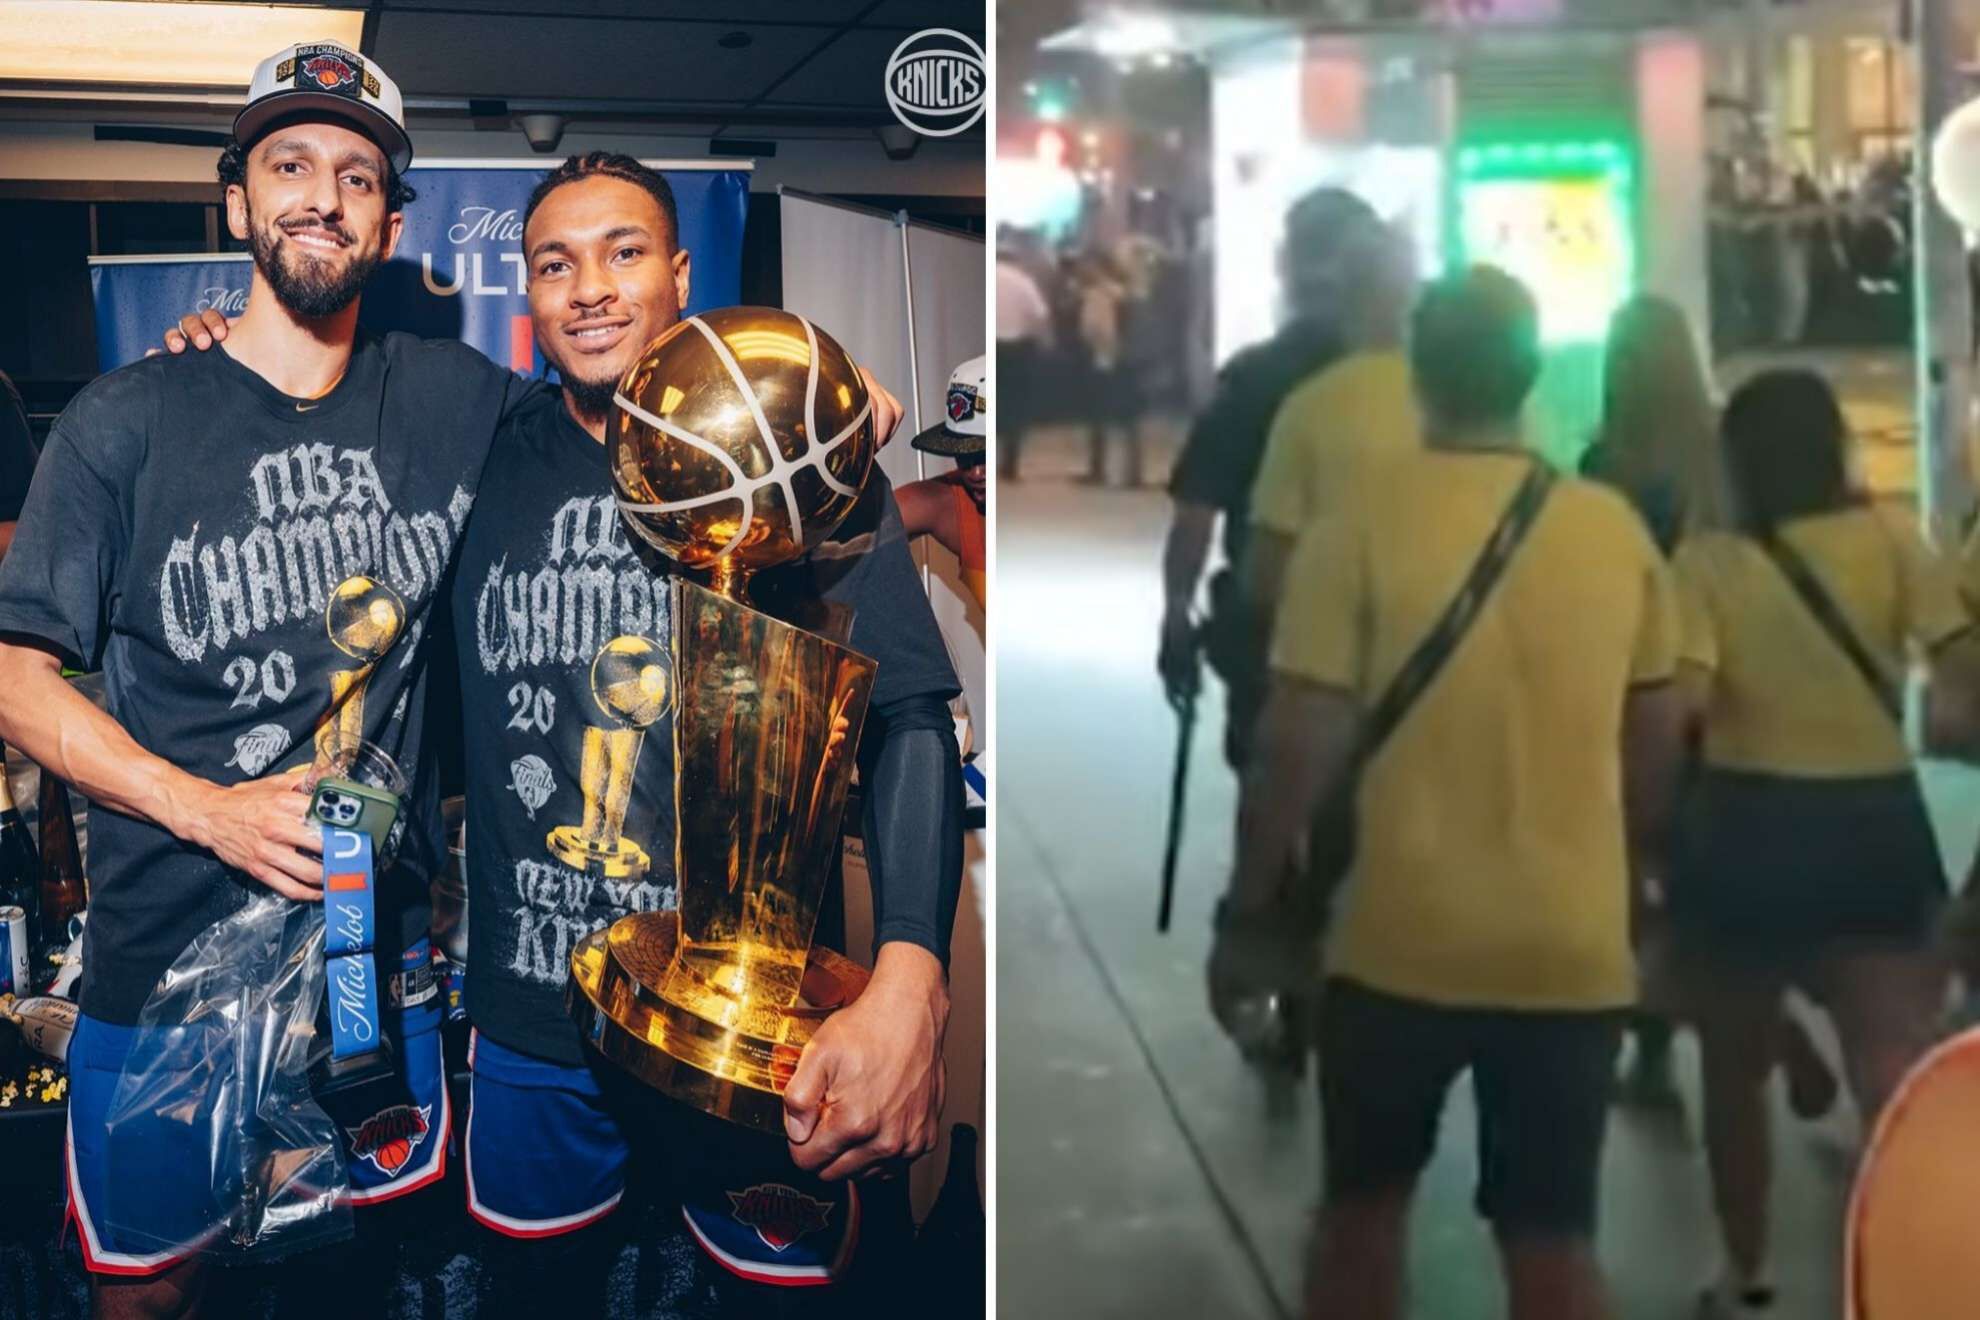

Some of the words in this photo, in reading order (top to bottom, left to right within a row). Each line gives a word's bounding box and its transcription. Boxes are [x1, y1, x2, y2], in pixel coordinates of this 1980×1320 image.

[297, 47, 314, 57] NBA
[448, 206, 524, 244] Mic
[196, 287, 249, 314] Mic
[422, 252, 528, 296] ULT
[249, 442, 392, 524] NBA
[477, 552, 671, 675] CHAMPI
[222, 649, 297, 711] 20
[506, 681, 556, 735] 20
[514, 858, 597, 915] NEW
